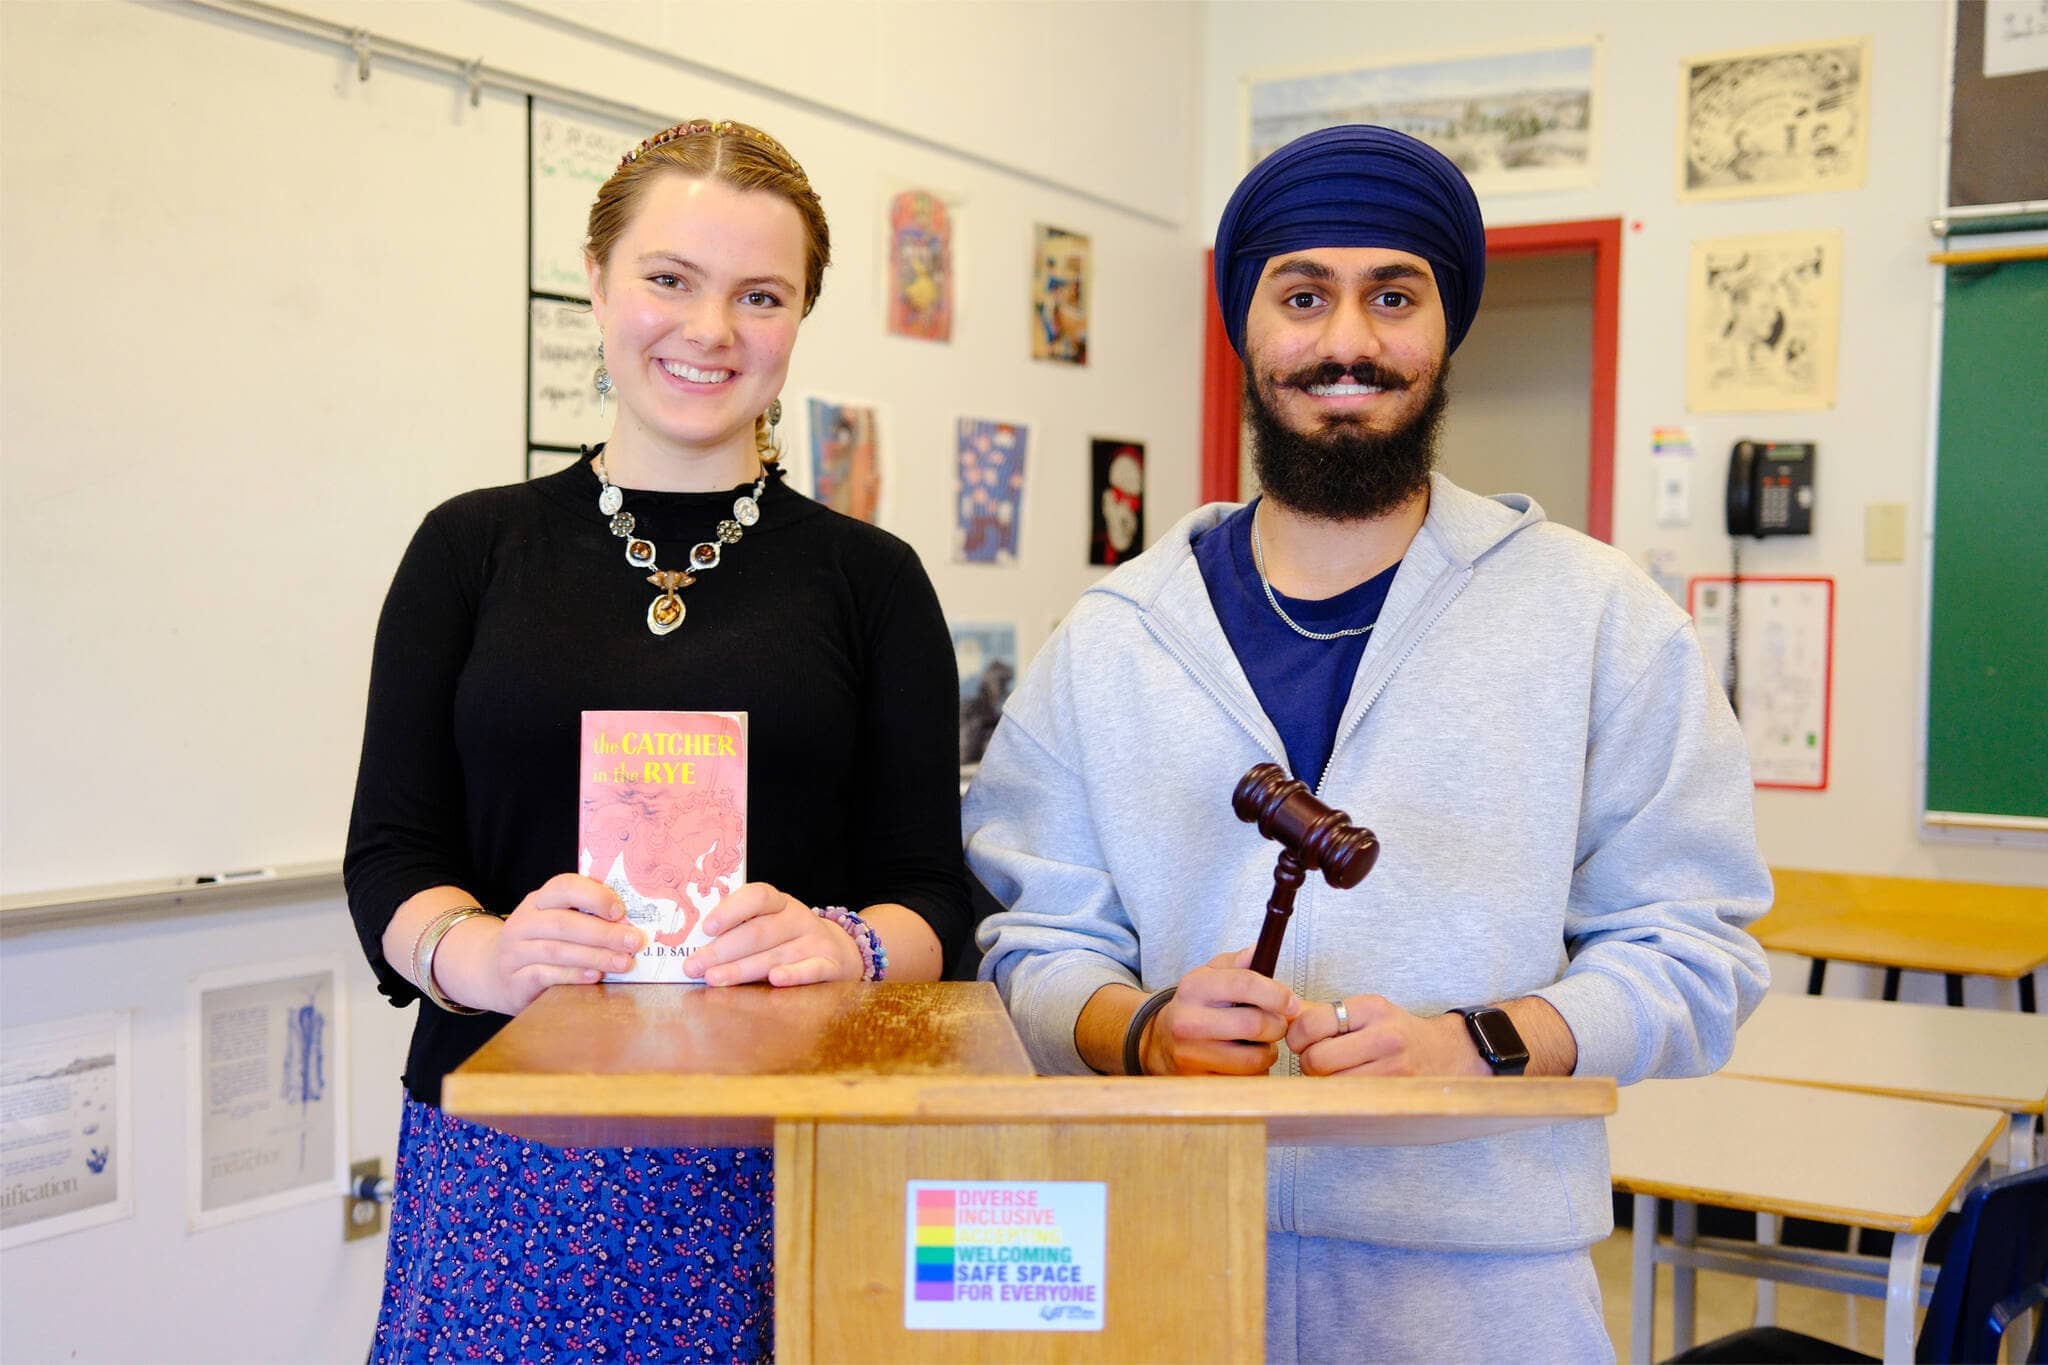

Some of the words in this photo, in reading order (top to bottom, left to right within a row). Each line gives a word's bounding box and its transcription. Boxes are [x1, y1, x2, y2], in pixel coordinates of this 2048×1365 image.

[592, 732, 618, 754] the
[622, 732, 736, 756] CATCHER
[593, 768, 608, 783] in
[613, 762, 638, 783] the
[644, 761, 696, 784] RYE
[643, 946, 653, 957] J.
[657, 946, 667, 957] D.
[959, 1190, 1038, 1206] DIVERSE
[959, 1209, 1055, 1225] INCLUSIVE
[959, 1228, 1062, 1244] ACCEPTING
[958, 1247, 1072, 1263] WELCOMING
[957, 1265, 1008, 1282] SAFE
[1017, 1265, 1082, 1282] SPACE
[957, 1285, 993, 1301] FOR
[1001, 1285, 1096, 1301] EVERYONE
